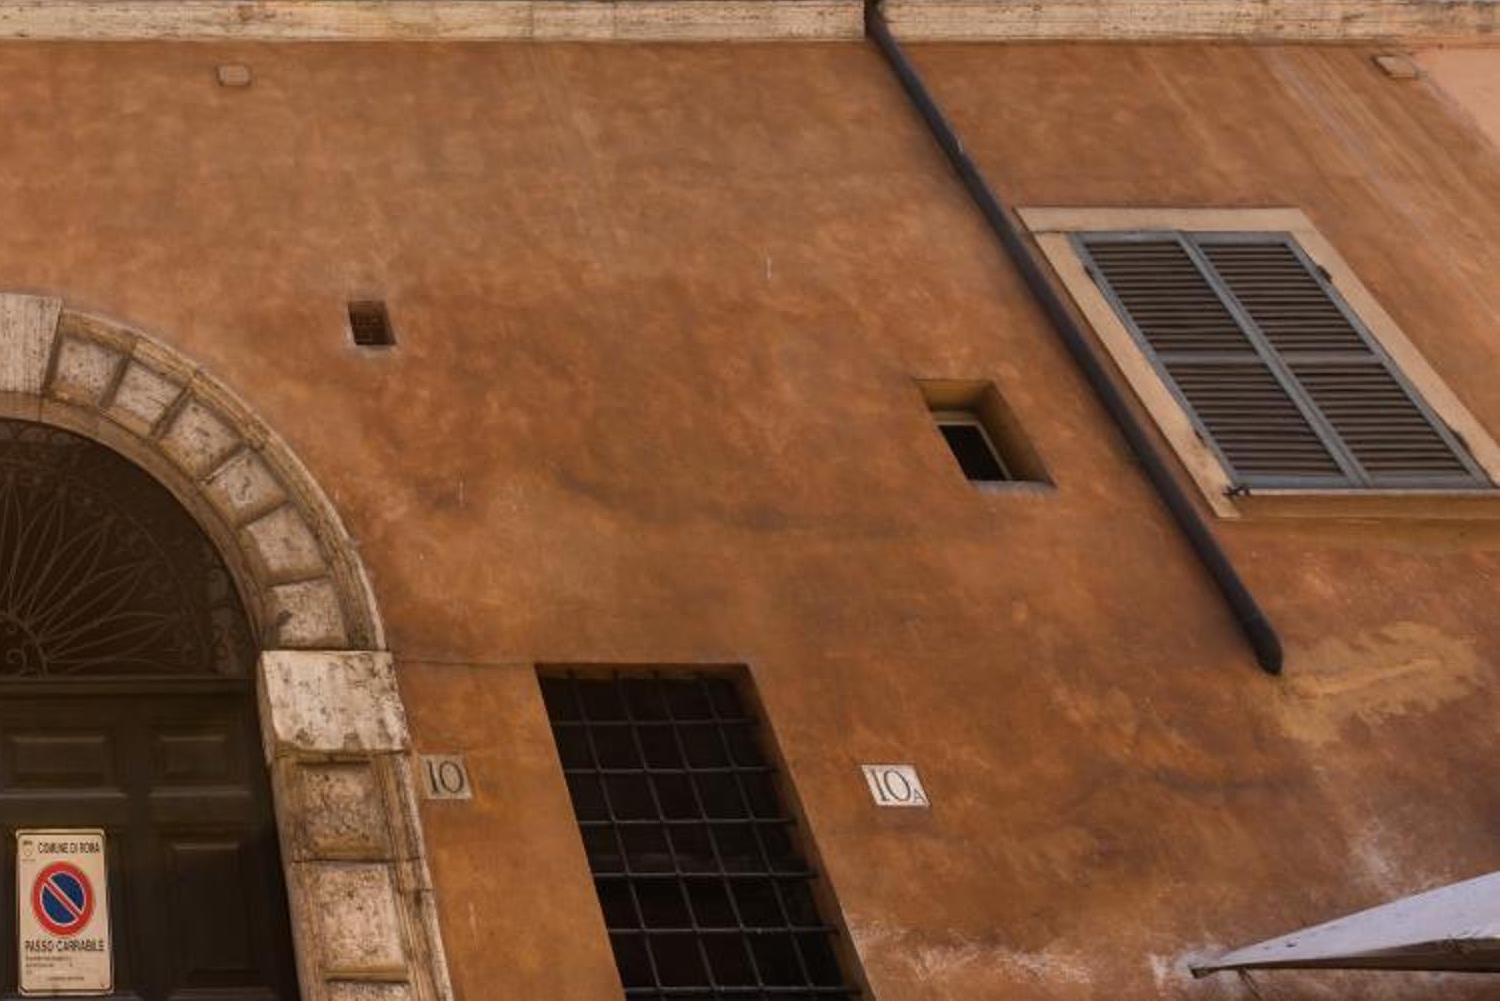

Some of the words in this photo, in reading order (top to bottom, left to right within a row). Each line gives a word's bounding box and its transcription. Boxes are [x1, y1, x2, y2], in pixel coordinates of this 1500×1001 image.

[426, 759, 464, 793] 10
[37, 841, 69, 854] COMUNE
[70, 841, 78, 854] DI
[79, 842, 100, 854] ROMA
[24, 939, 54, 952] PASSO
[55, 939, 105, 952] CARRABILE
